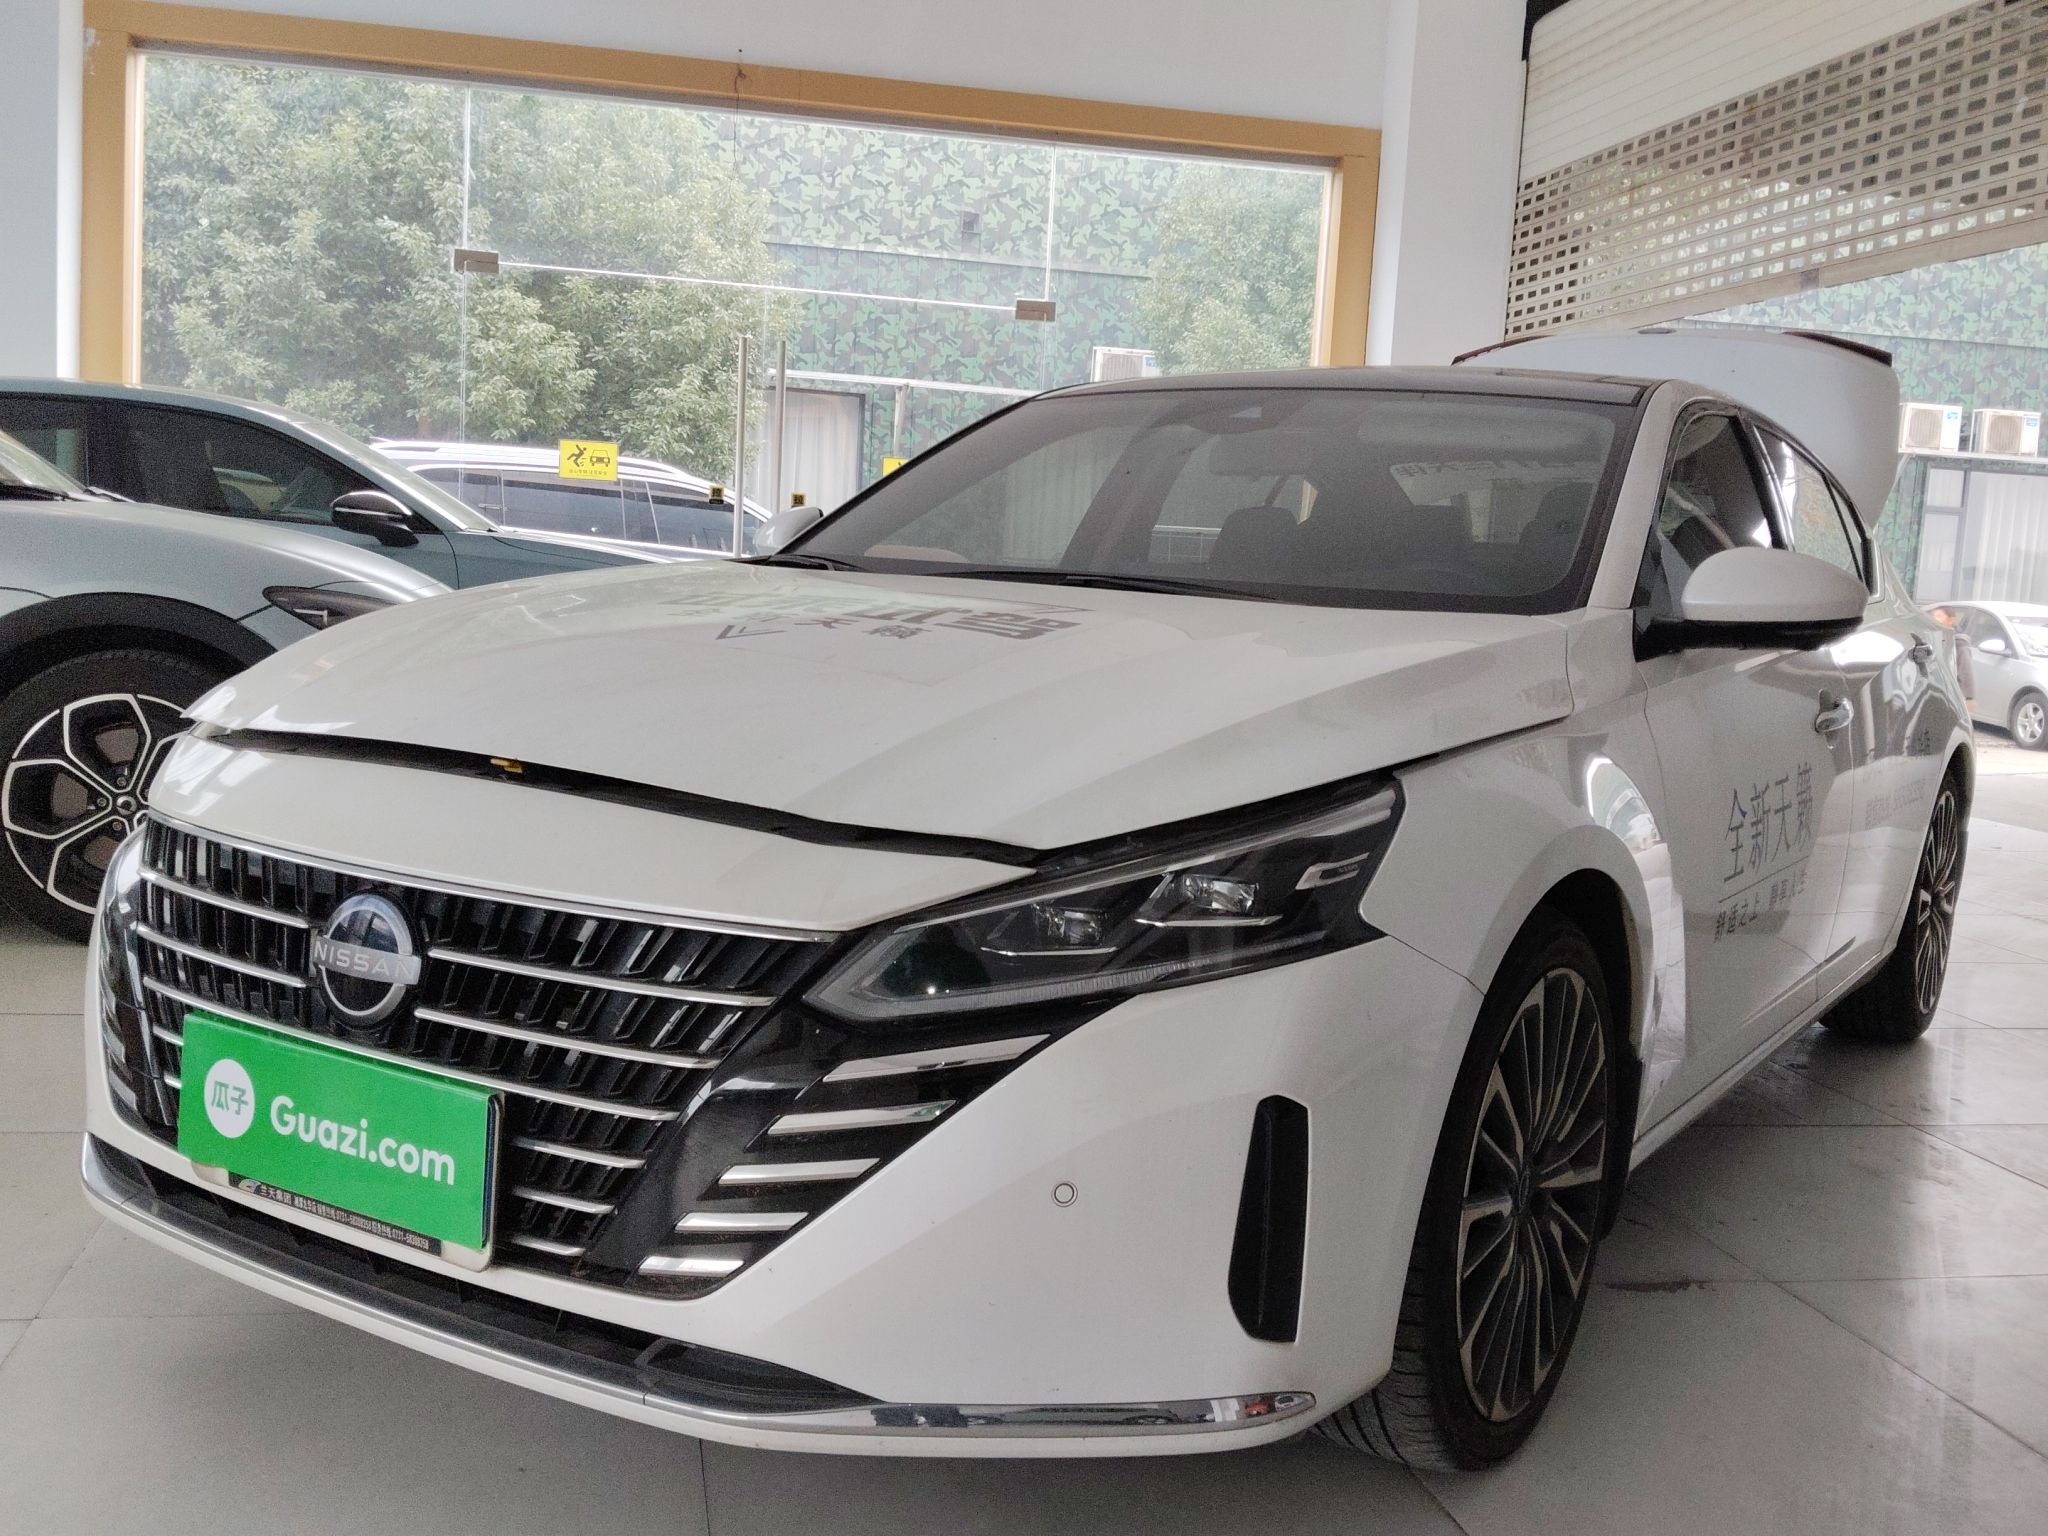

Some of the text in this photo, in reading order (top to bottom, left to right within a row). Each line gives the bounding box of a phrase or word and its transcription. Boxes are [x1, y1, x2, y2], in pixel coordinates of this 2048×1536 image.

[314, 940, 413, 978] NISSAN
[211, 1079, 249, 1117] 瓜子
[270, 1094, 456, 1186] Guazi.com
